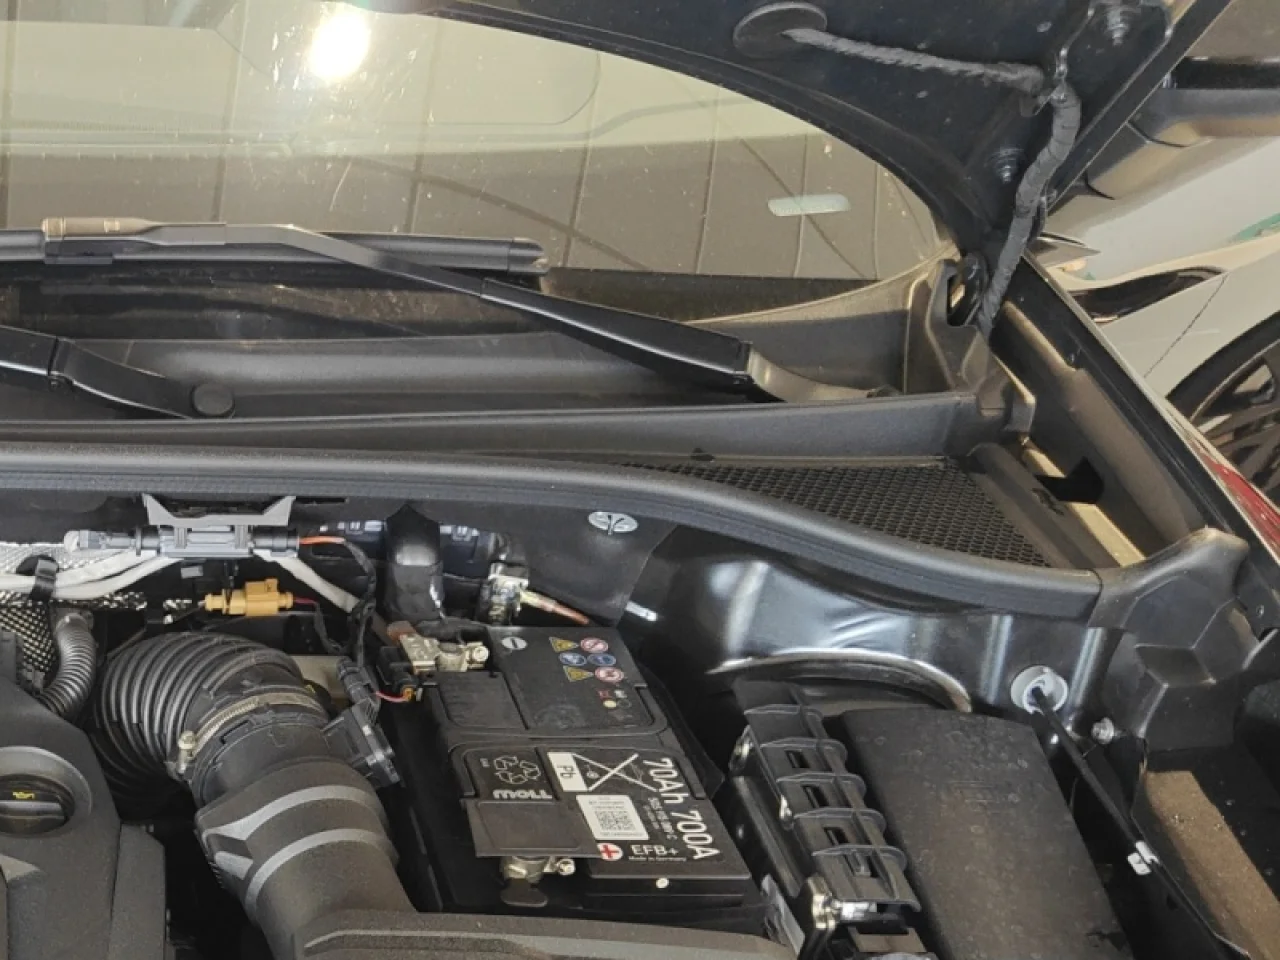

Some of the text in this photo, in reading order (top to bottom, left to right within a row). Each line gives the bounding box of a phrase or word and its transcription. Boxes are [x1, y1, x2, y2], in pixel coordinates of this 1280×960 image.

[643, 757, 689, 804] 70Ah
[670, 810, 720, 860] 700A
[630, 844, 679, 855] EFB+
